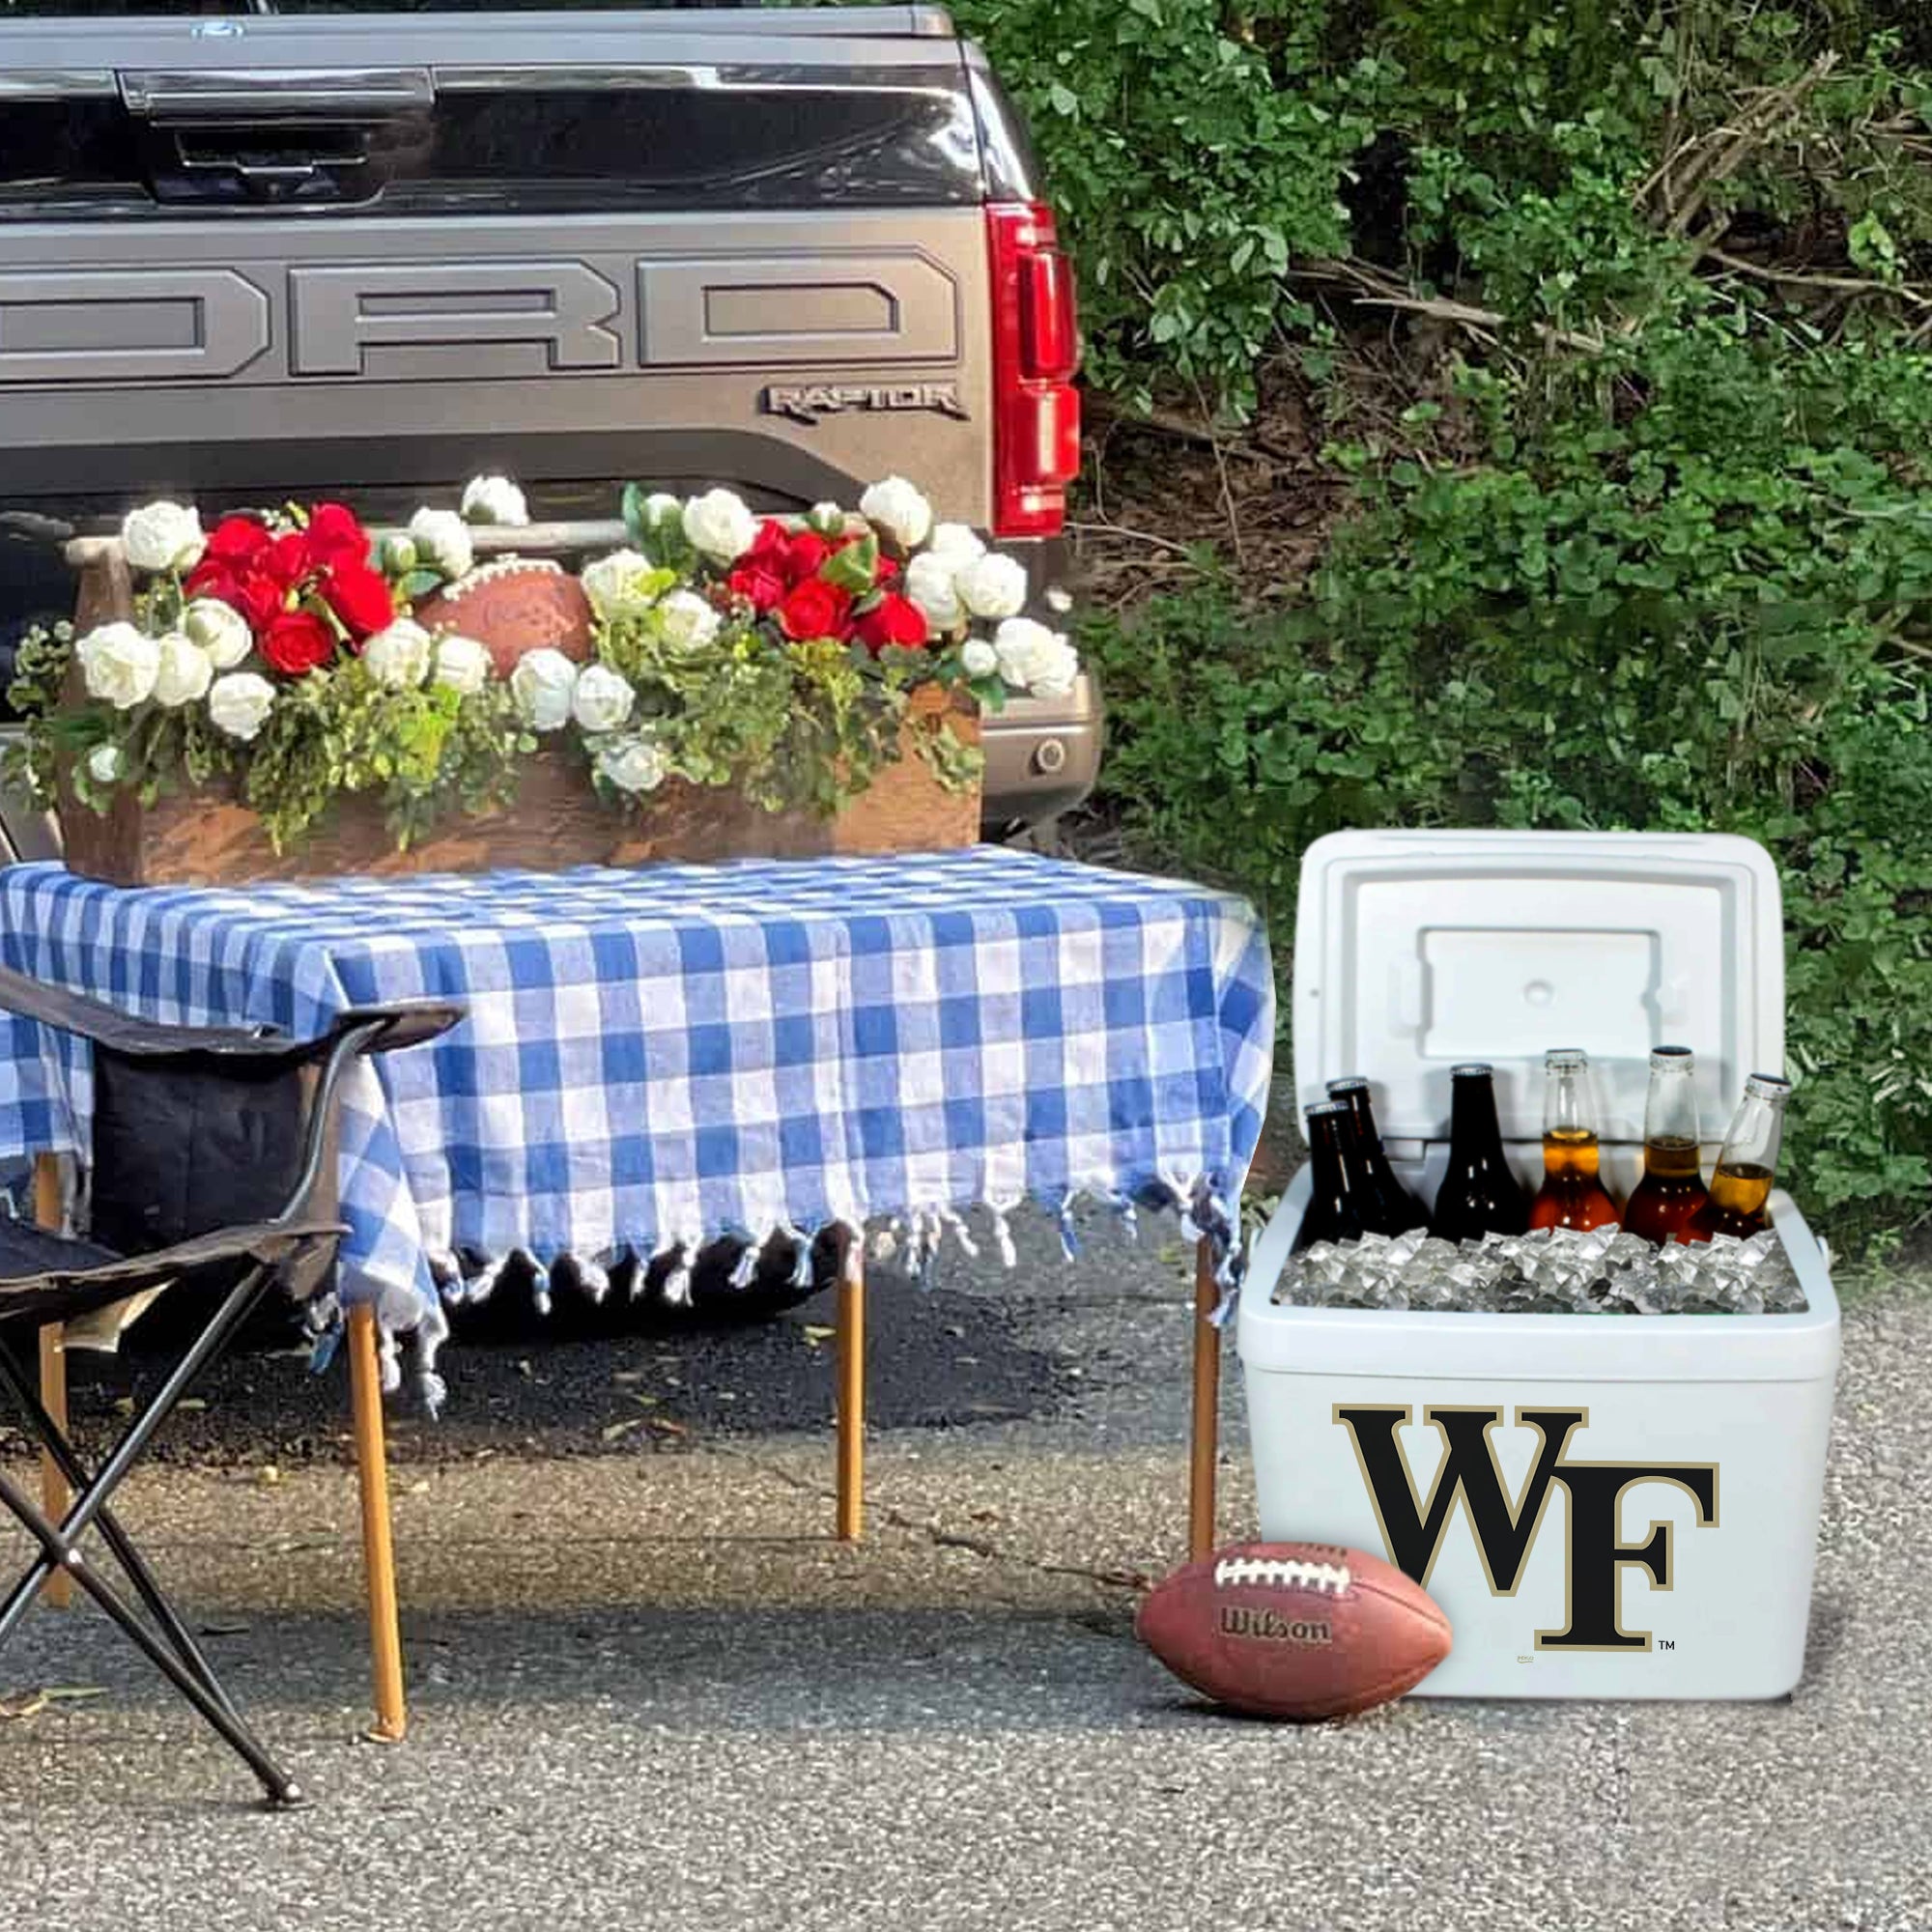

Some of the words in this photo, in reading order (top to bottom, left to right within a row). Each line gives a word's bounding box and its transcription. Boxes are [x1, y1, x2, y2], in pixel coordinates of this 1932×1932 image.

[761, 385, 968, 425] RAPTOR
[1332, 1404, 1719, 1651] WF
[1220, 1607, 1329, 1639] Wilson
[1658, 1640, 1675, 1650] TM
